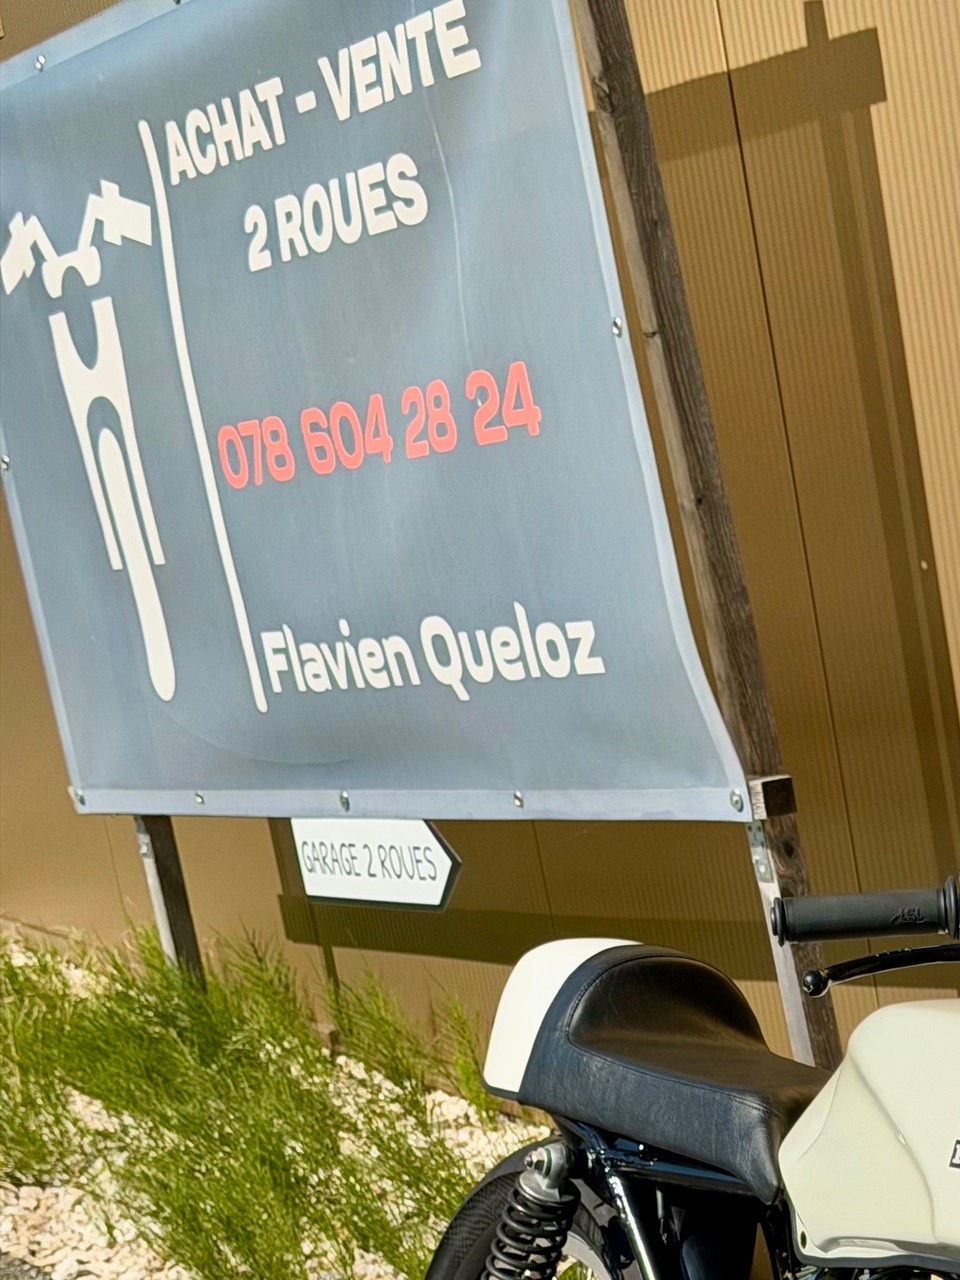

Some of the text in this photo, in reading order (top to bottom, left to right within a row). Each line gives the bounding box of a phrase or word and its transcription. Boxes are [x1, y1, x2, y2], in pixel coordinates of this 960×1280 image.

[166, 77, 286, 186] ACHAT
[318, 0, 482, 121] VENTE
[244, 153, 428, 272] 2 ROUES
[217, 361, 542, 490] 078 604 28 24
[260, 602, 606, 701] Flavien Queloz
[301, 840, 437, 882] GARAGE 2 ROUES
